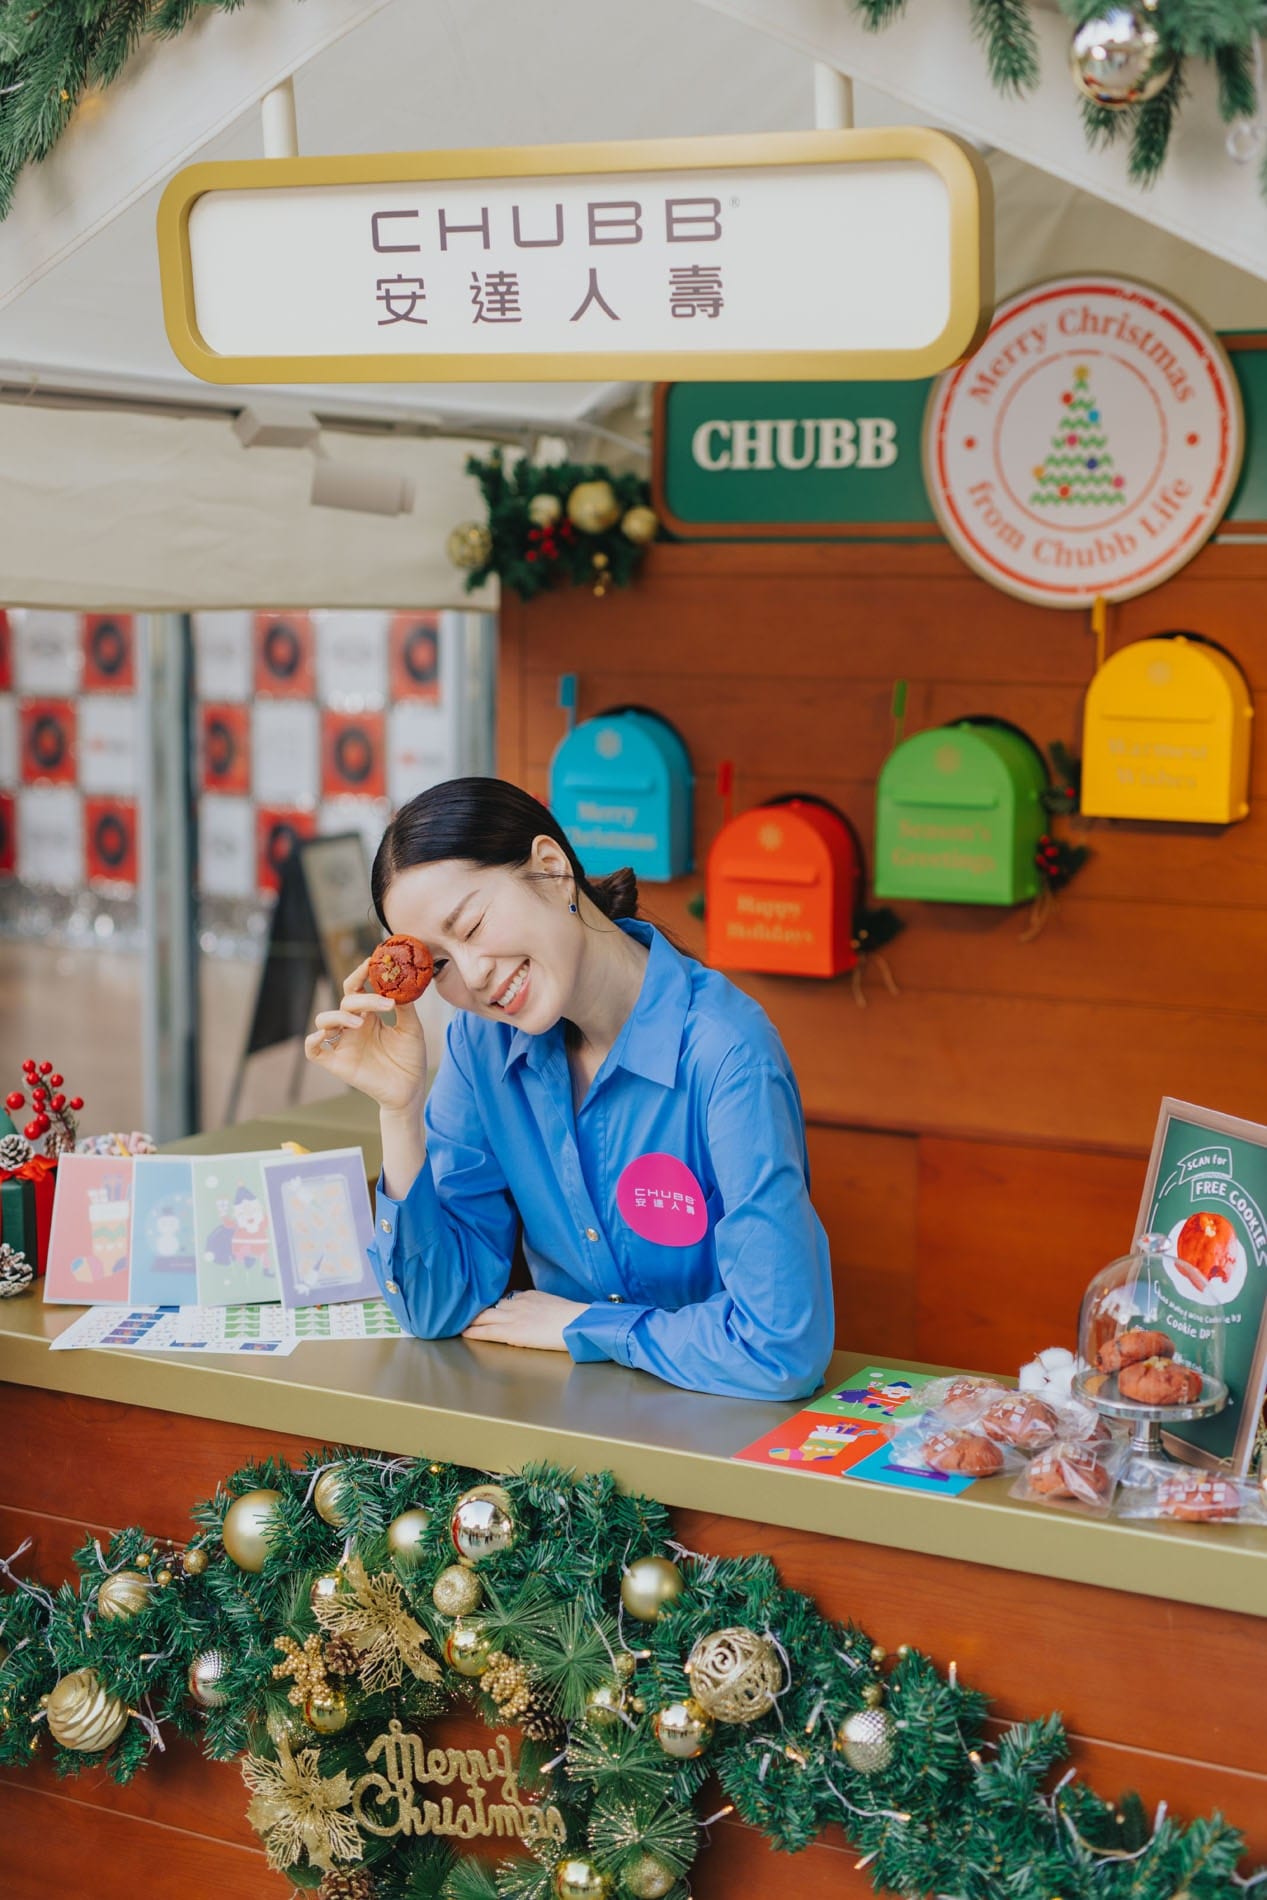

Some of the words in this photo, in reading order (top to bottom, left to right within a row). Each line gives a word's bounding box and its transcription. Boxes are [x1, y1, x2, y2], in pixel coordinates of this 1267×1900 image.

[371, 197, 723, 254] CHUBB
[375, 264, 725, 326] 安達人壽
[968, 320, 1048, 405] Merry
[1057, 304, 1195, 404] Christmas
[692, 418, 898, 470] CHUBB
[968, 479, 1027, 553] from
[1031, 531, 1139, 568] Chubb
[1139, 478, 1192, 538] Life
[577, 801, 637, 828] Merry
[736, 894, 803, 920] Happy
[1187, 1156, 1210, 1170] SCAN
[1212, 1154, 1227, 1166] for
[634, 1188, 695, 1205] CHUBB
[1195, 1181, 1227, 1196] FREE
[1166, 1314, 1197, 1338] Cookie
[365, 1732, 520, 1803] Merry
[351, 1773, 567, 1844] Christmas
